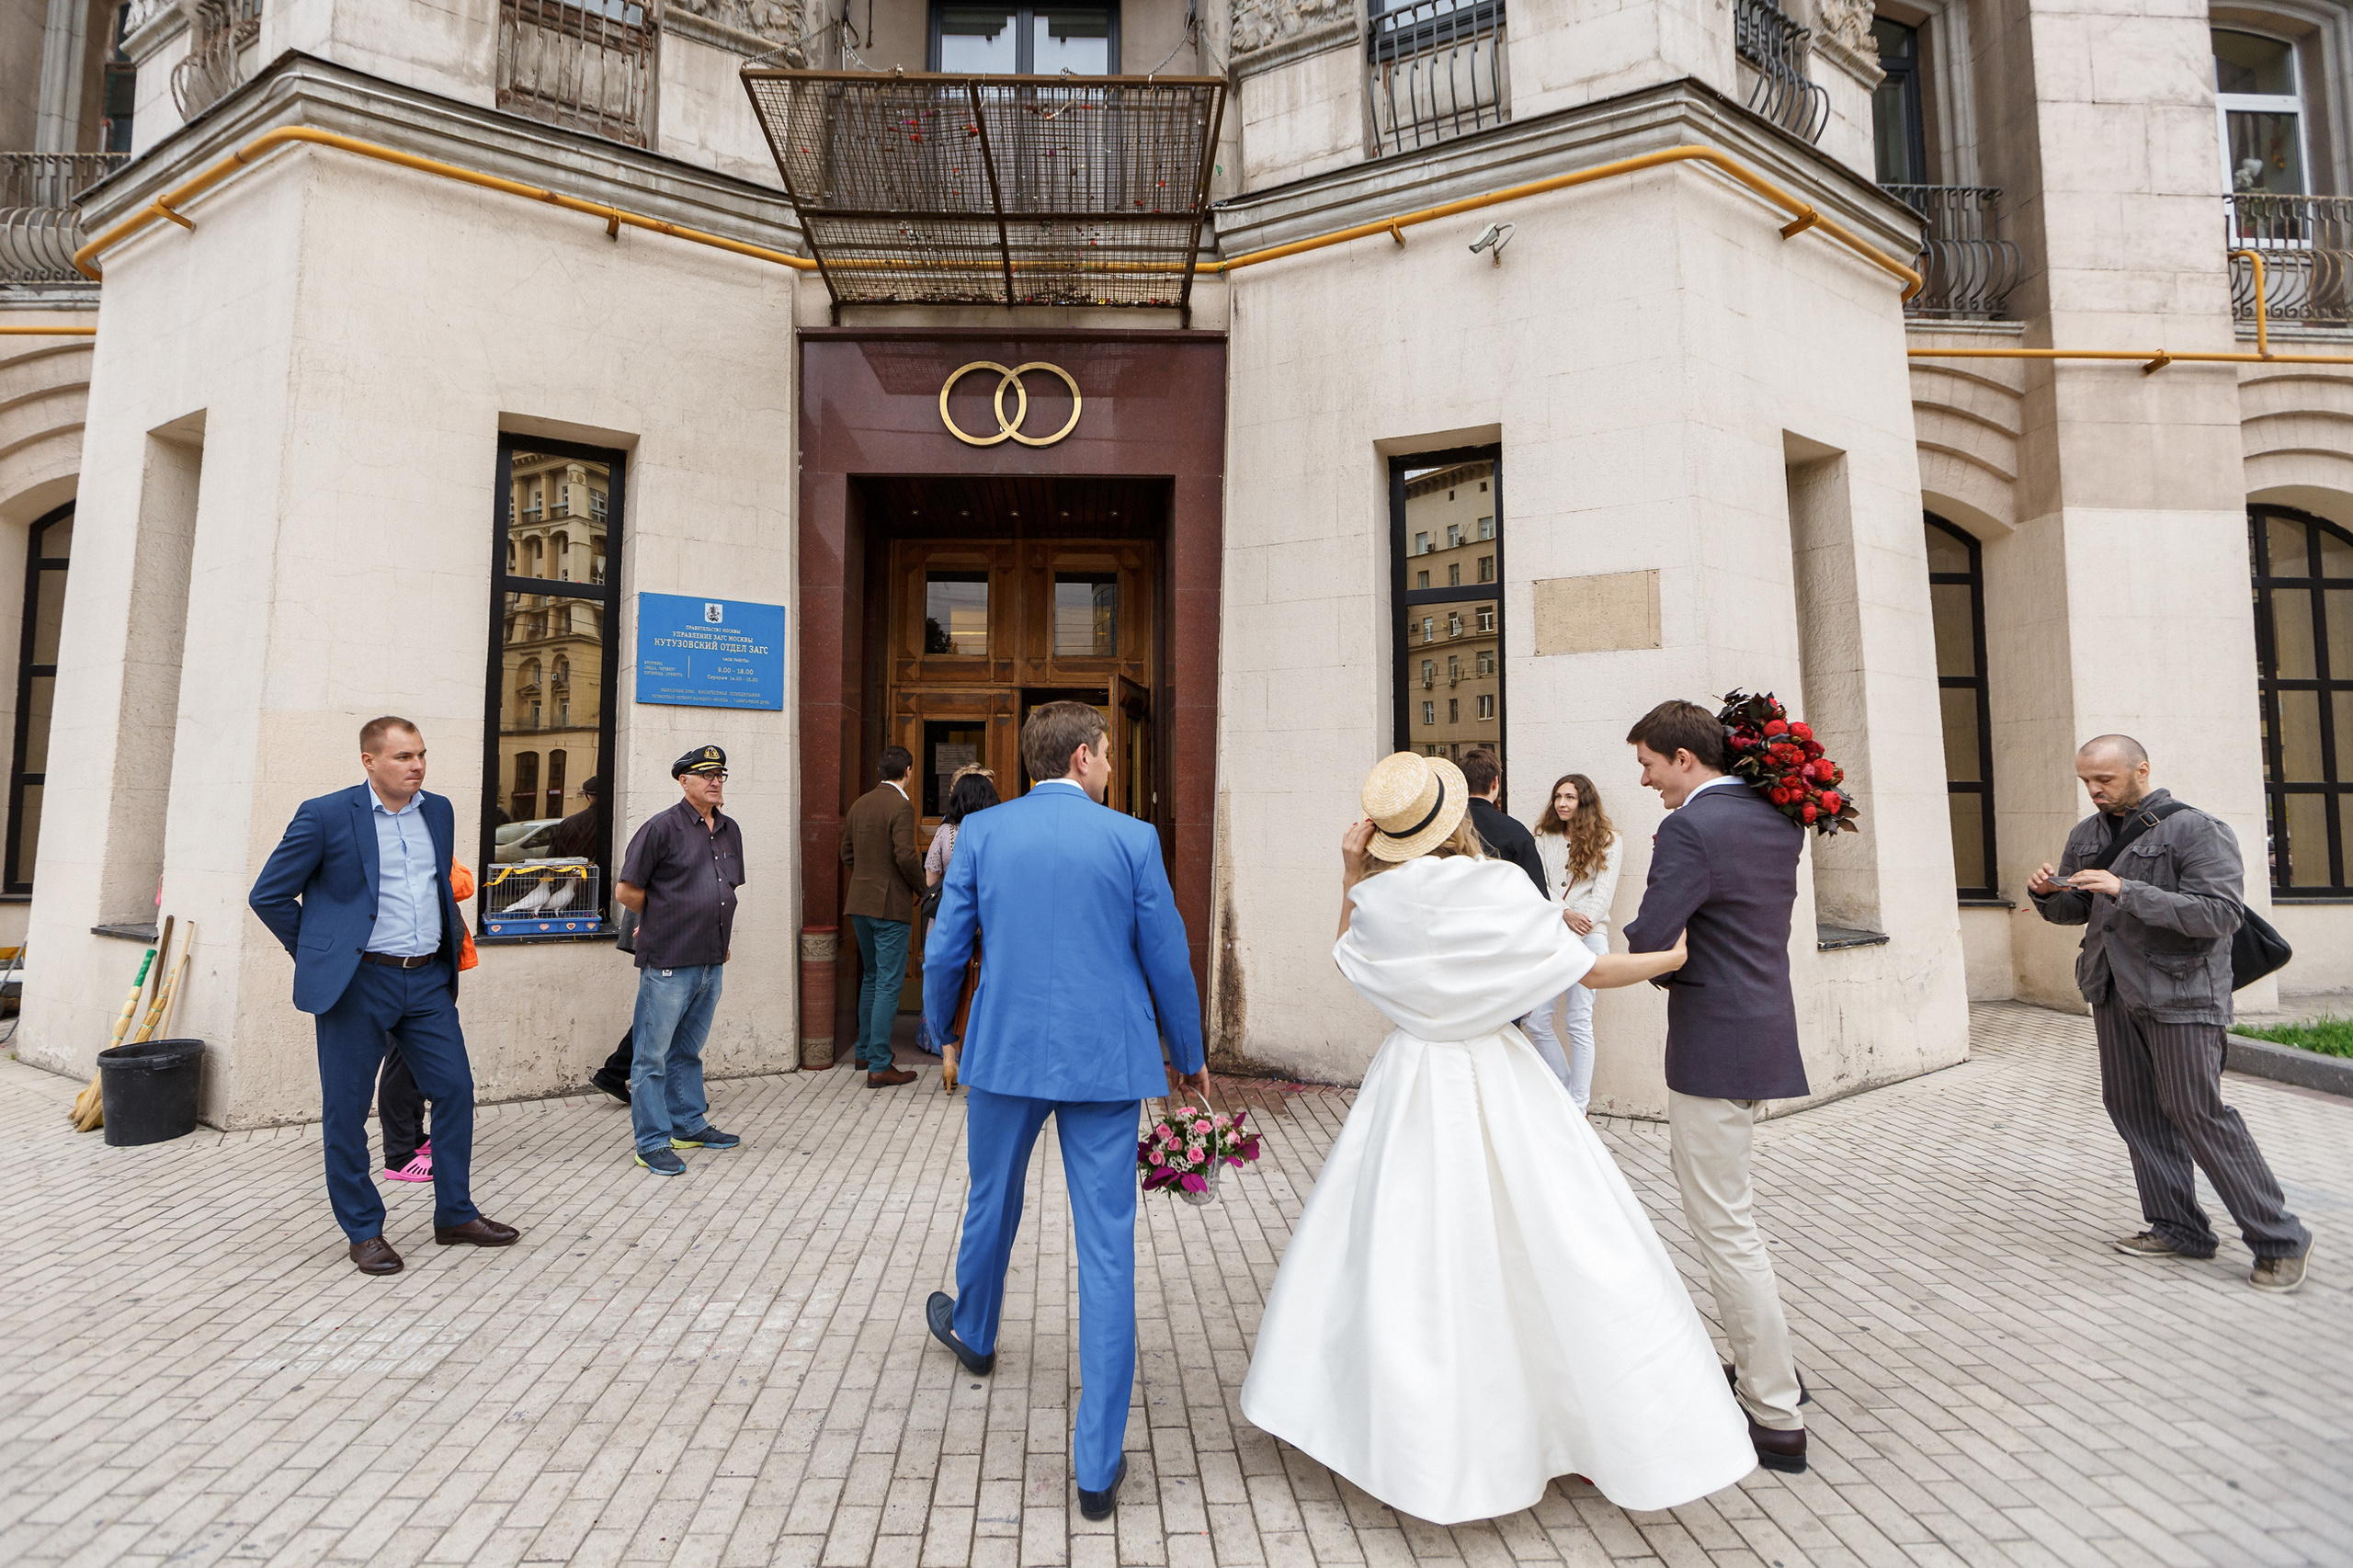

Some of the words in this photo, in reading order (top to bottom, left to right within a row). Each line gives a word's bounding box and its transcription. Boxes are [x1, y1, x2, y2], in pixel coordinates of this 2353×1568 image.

[672, 631, 712, 640] УПРАВЛЕНИЕ
[654, 637, 718, 650] КУТУЗОВСКИЙ
[720, 642, 747, 653] ОТДЕЛ
[748, 645, 768, 654] ЗАГС
